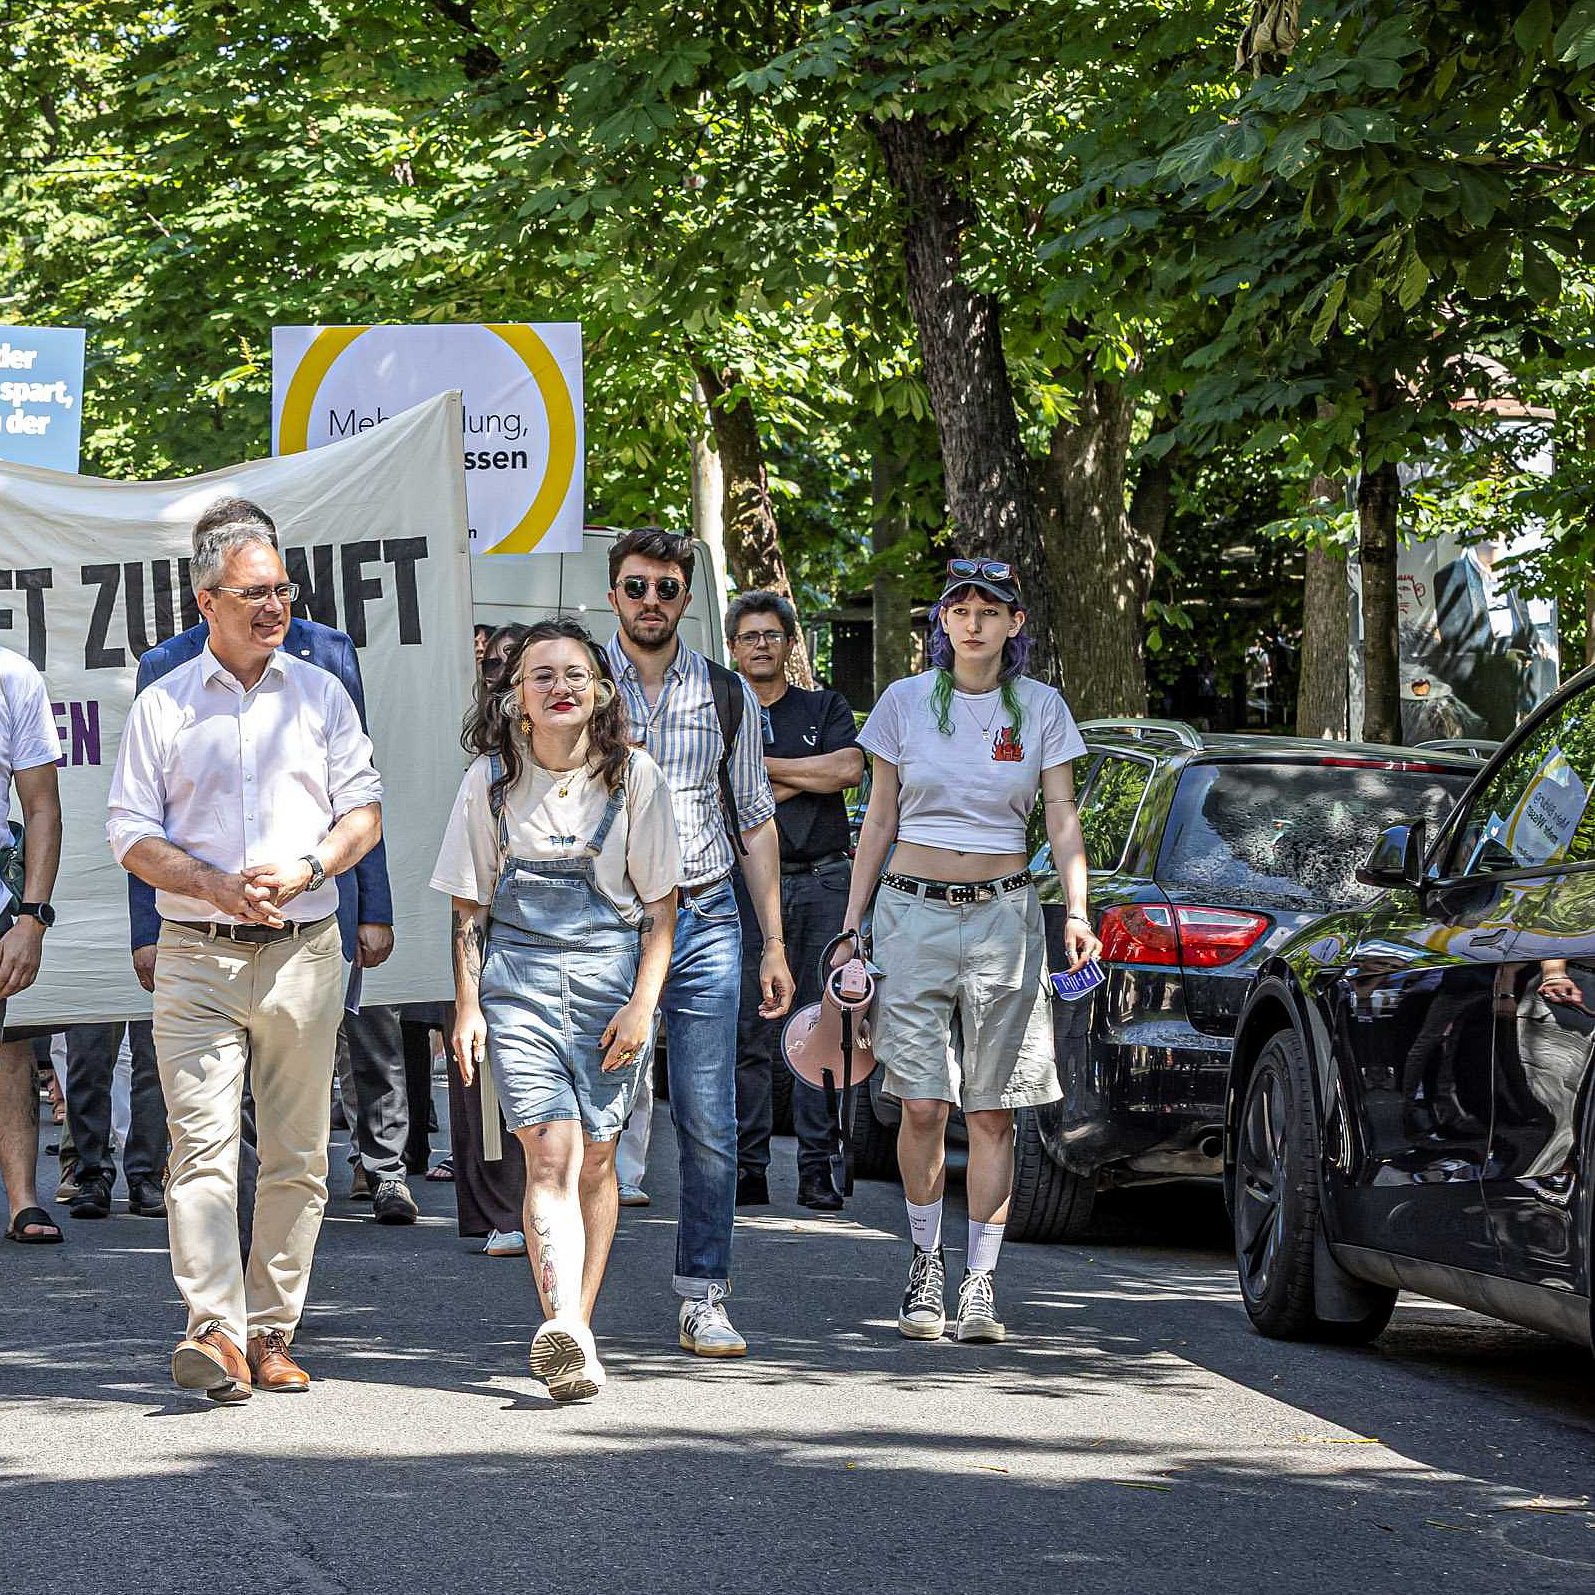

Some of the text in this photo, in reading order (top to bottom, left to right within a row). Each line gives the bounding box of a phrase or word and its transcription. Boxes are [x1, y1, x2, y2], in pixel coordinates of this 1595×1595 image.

[0, 381, 73, 409] spart,
[6, 409, 50, 435] der
[329, 407, 391, 437] Meh
[463, 450, 528, 470] ssen
[80, 536, 429, 670] ZUNFT
